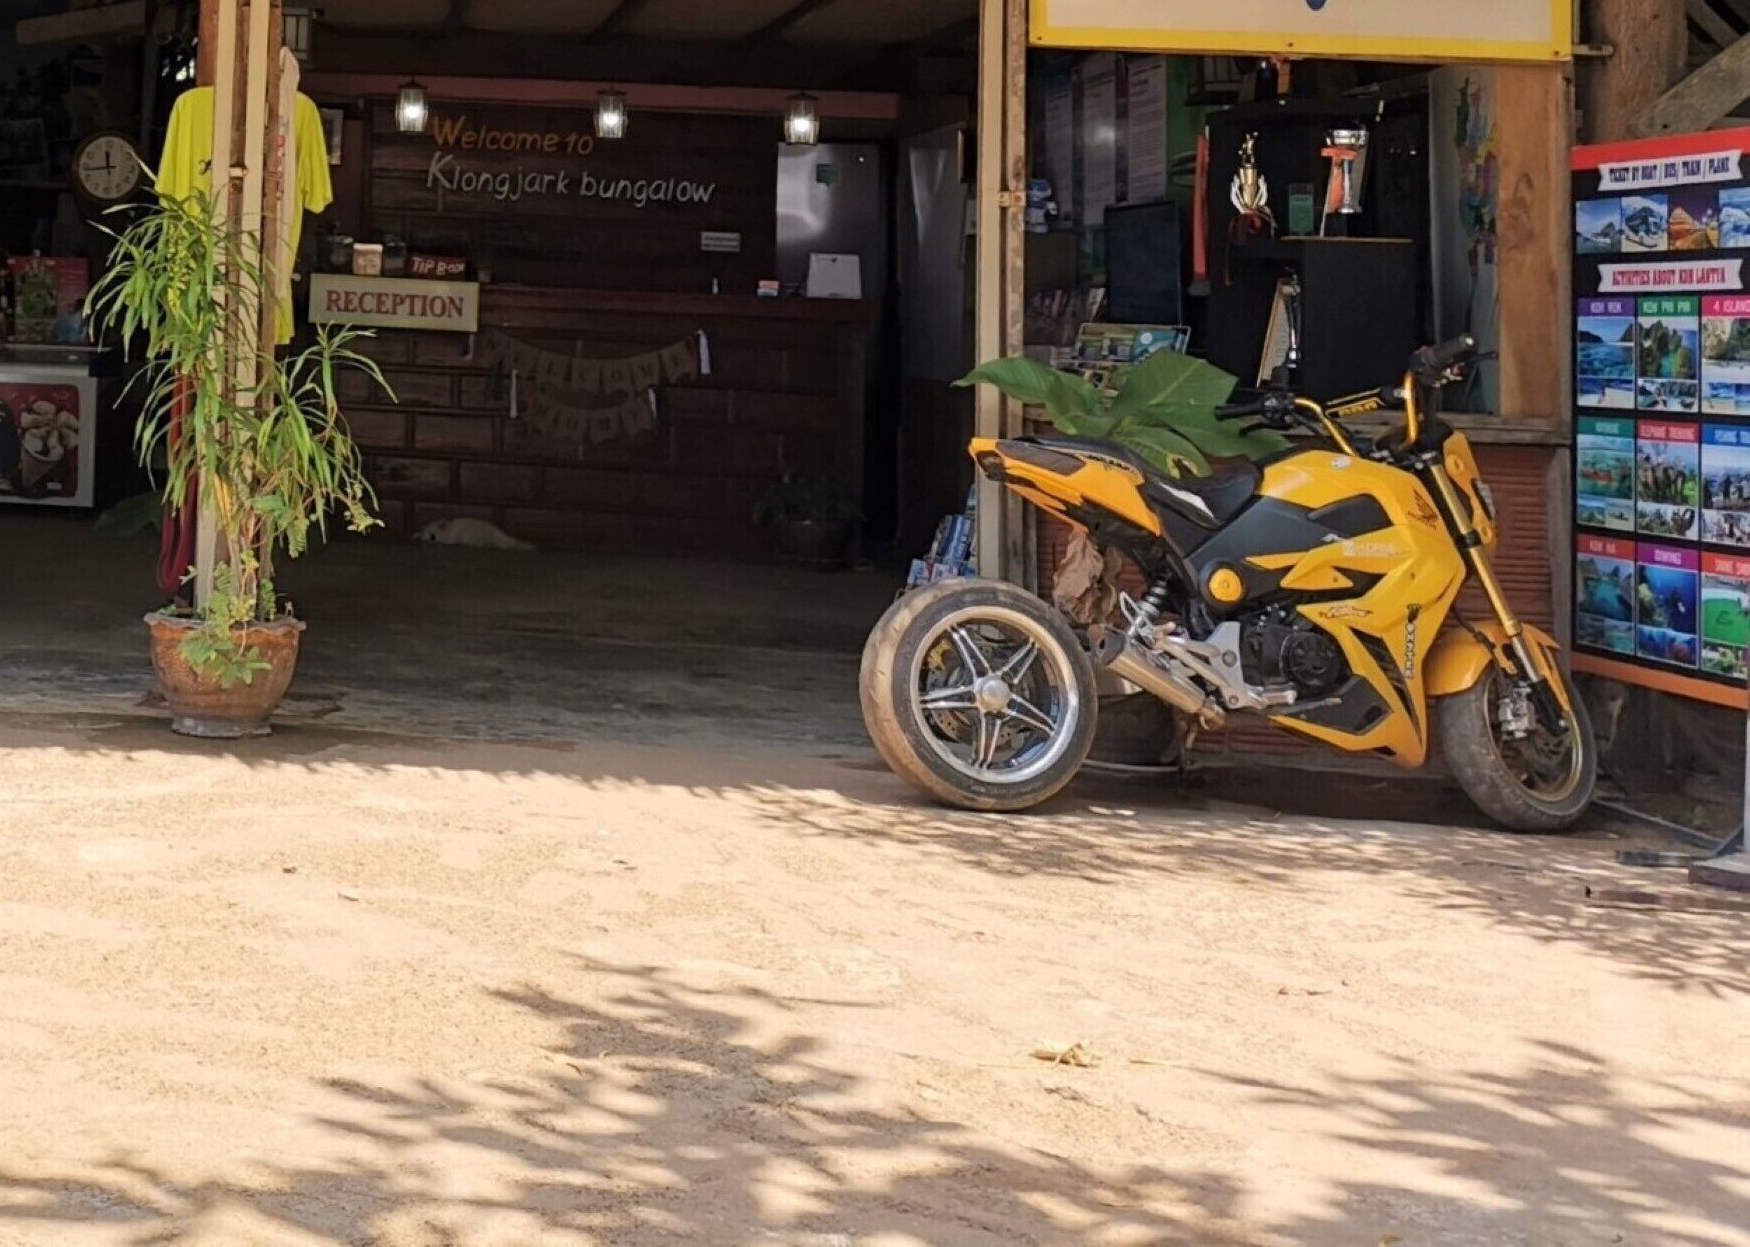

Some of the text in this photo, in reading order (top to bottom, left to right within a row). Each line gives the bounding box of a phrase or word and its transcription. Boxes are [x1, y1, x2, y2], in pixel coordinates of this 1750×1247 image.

[432, 115, 595, 155] Welcome to
[579, 170, 716, 208] bungalow
[325, 289, 464, 318] RECEPTION
